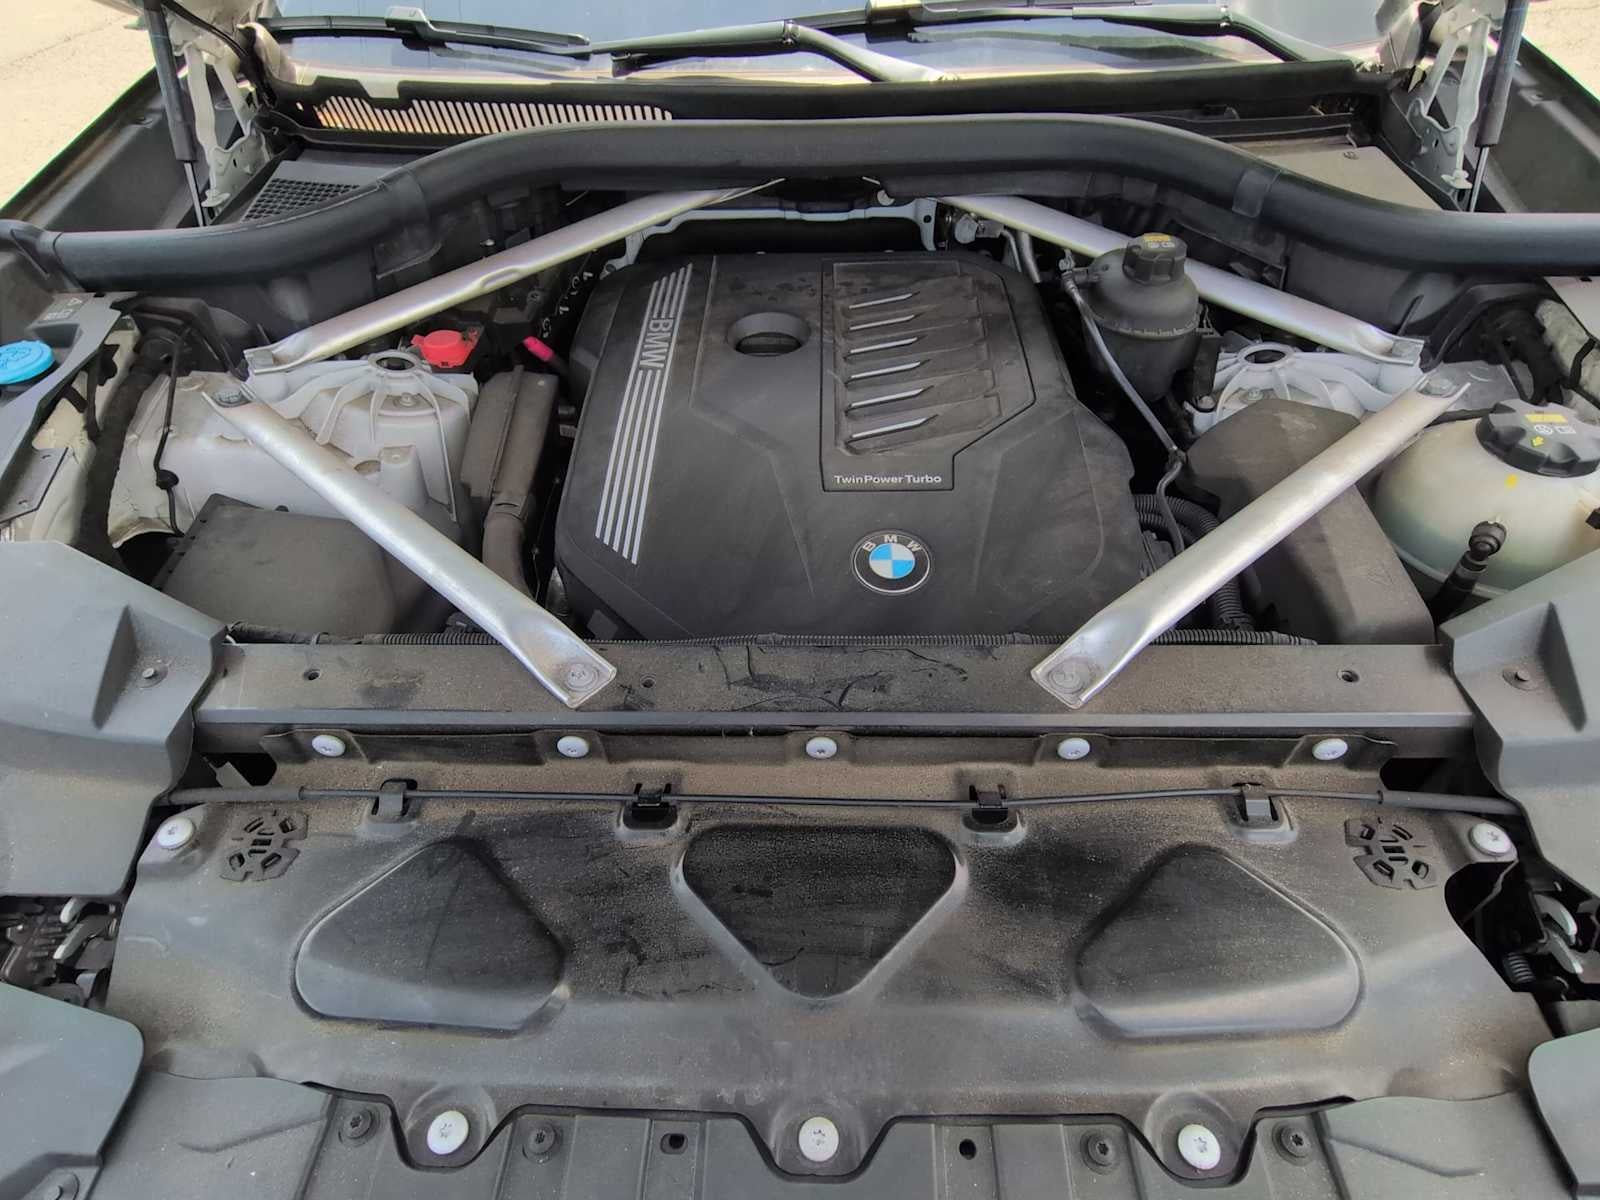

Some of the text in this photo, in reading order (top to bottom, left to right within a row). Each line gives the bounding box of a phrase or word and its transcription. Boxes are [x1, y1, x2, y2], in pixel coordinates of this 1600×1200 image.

[640, 319, 674, 368] BMW
[834, 474, 942, 484] TwinPower Turbo
[862, 534, 922, 553] BMW
